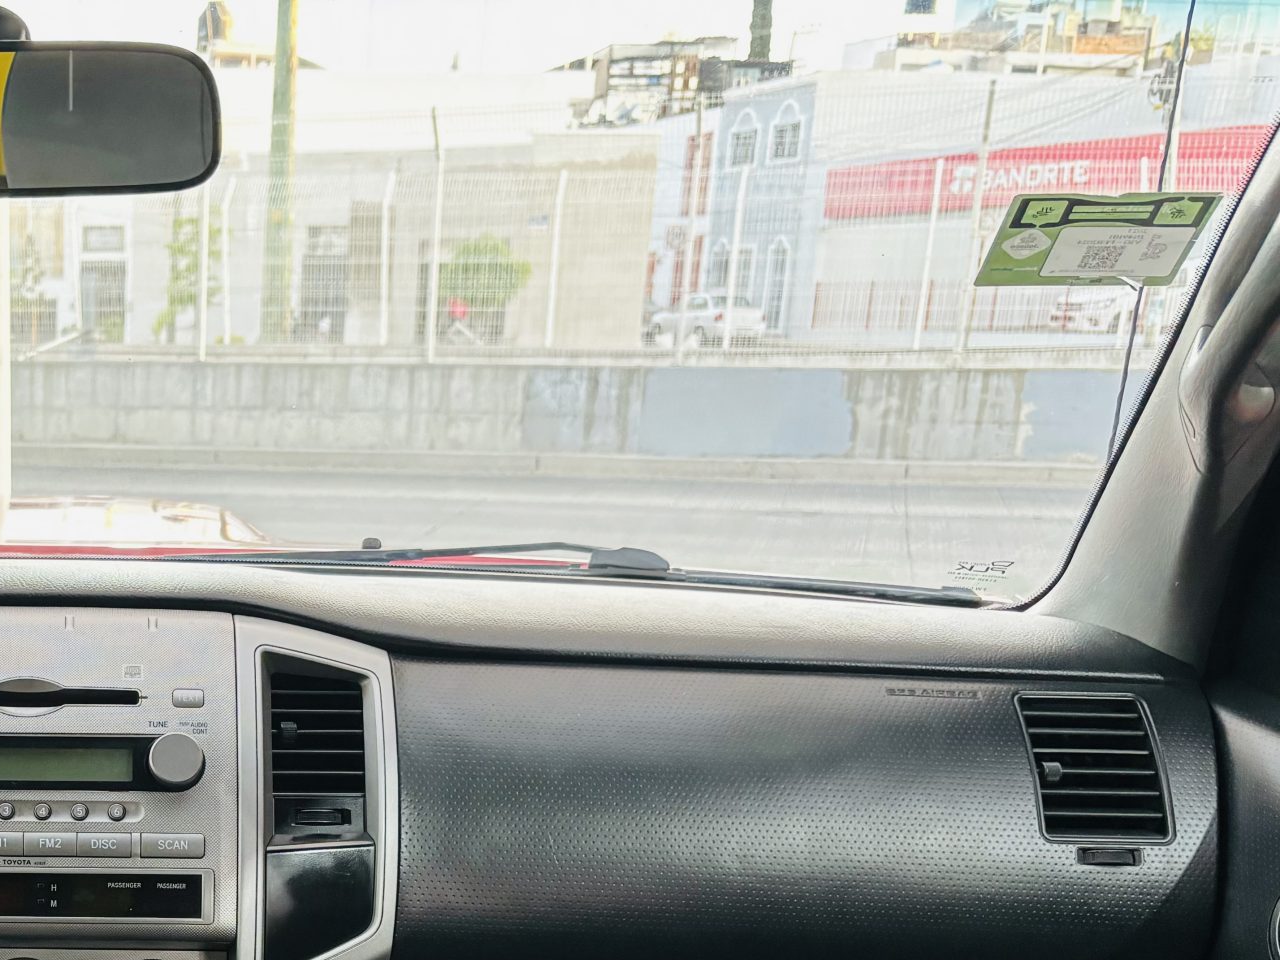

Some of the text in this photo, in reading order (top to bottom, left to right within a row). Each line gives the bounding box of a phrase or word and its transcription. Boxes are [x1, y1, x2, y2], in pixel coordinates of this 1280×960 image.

[148, 720, 169, 728] TUNE
[39, 838, 62, 849] FM2
[91, 839, 117, 850] DISC
[158, 840, 188, 850] SCAN
[51, 884, 57, 892] H
[156, 882, 187, 890] PASSENGER
[51, 899, 58, 908] M
